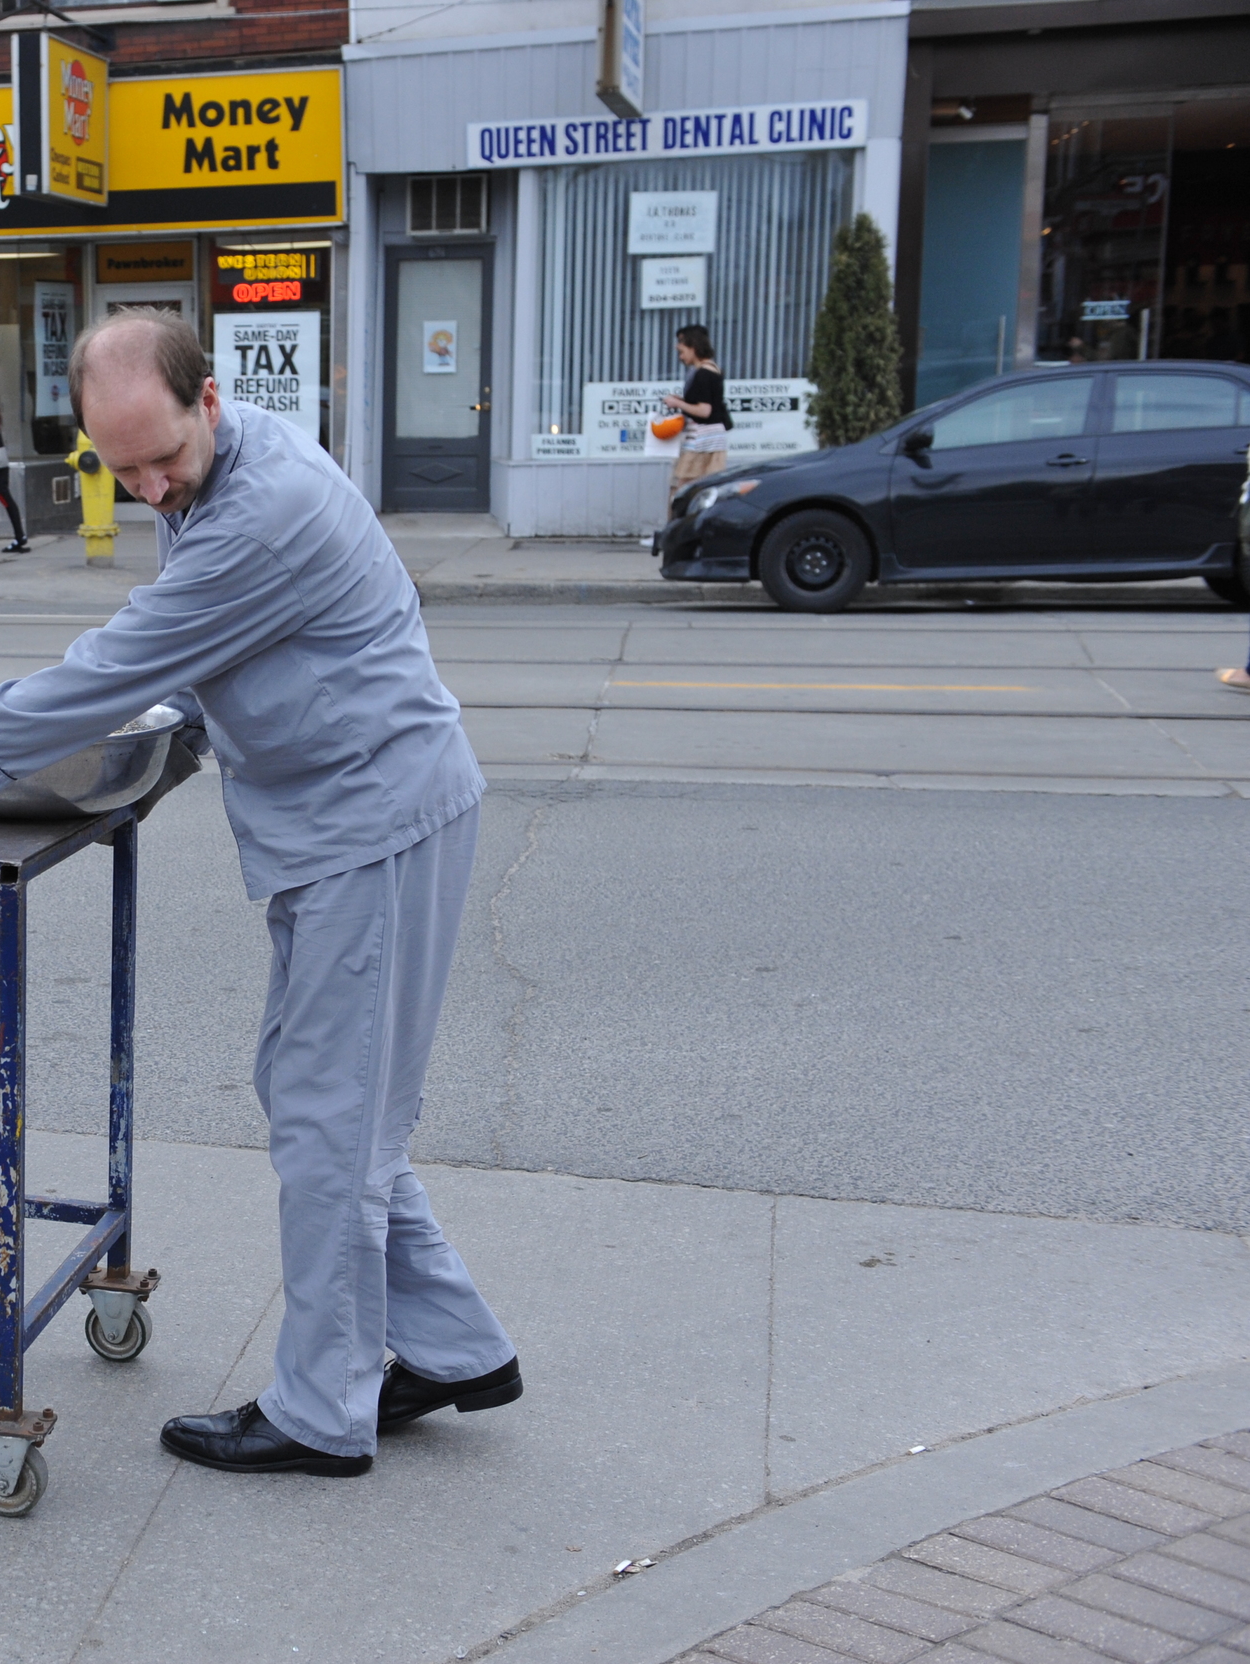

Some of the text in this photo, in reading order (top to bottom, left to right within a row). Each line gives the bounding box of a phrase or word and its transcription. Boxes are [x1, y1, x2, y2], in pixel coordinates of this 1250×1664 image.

[60, 59, 93, 110] Money
[64, 99, 89, 141] Mart
[162, 92, 309, 132] Money
[480, 106, 854, 163] QUEEN STREET DENTAL CLINIC
[183, 136, 279, 174] Mart
[107, 256, 185, 270] Pawnbroker
[217, 253, 301, 269] WESTERN
[243, 266, 301, 281] UNION
[233, 281, 301, 303] OPEN
[41, 311, 68, 342] TAX
[234, 329, 299, 342] SAME-DAY
[234, 344, 300, 376] TAX
[234, 377, 300, 394] REFUND
[612, 387, 647, 397] FAMILY
[652, 388, 670, 396] AND
[729, 384, 791, 395] DENTISTRY
[254, 395, 300, 412] CASH
